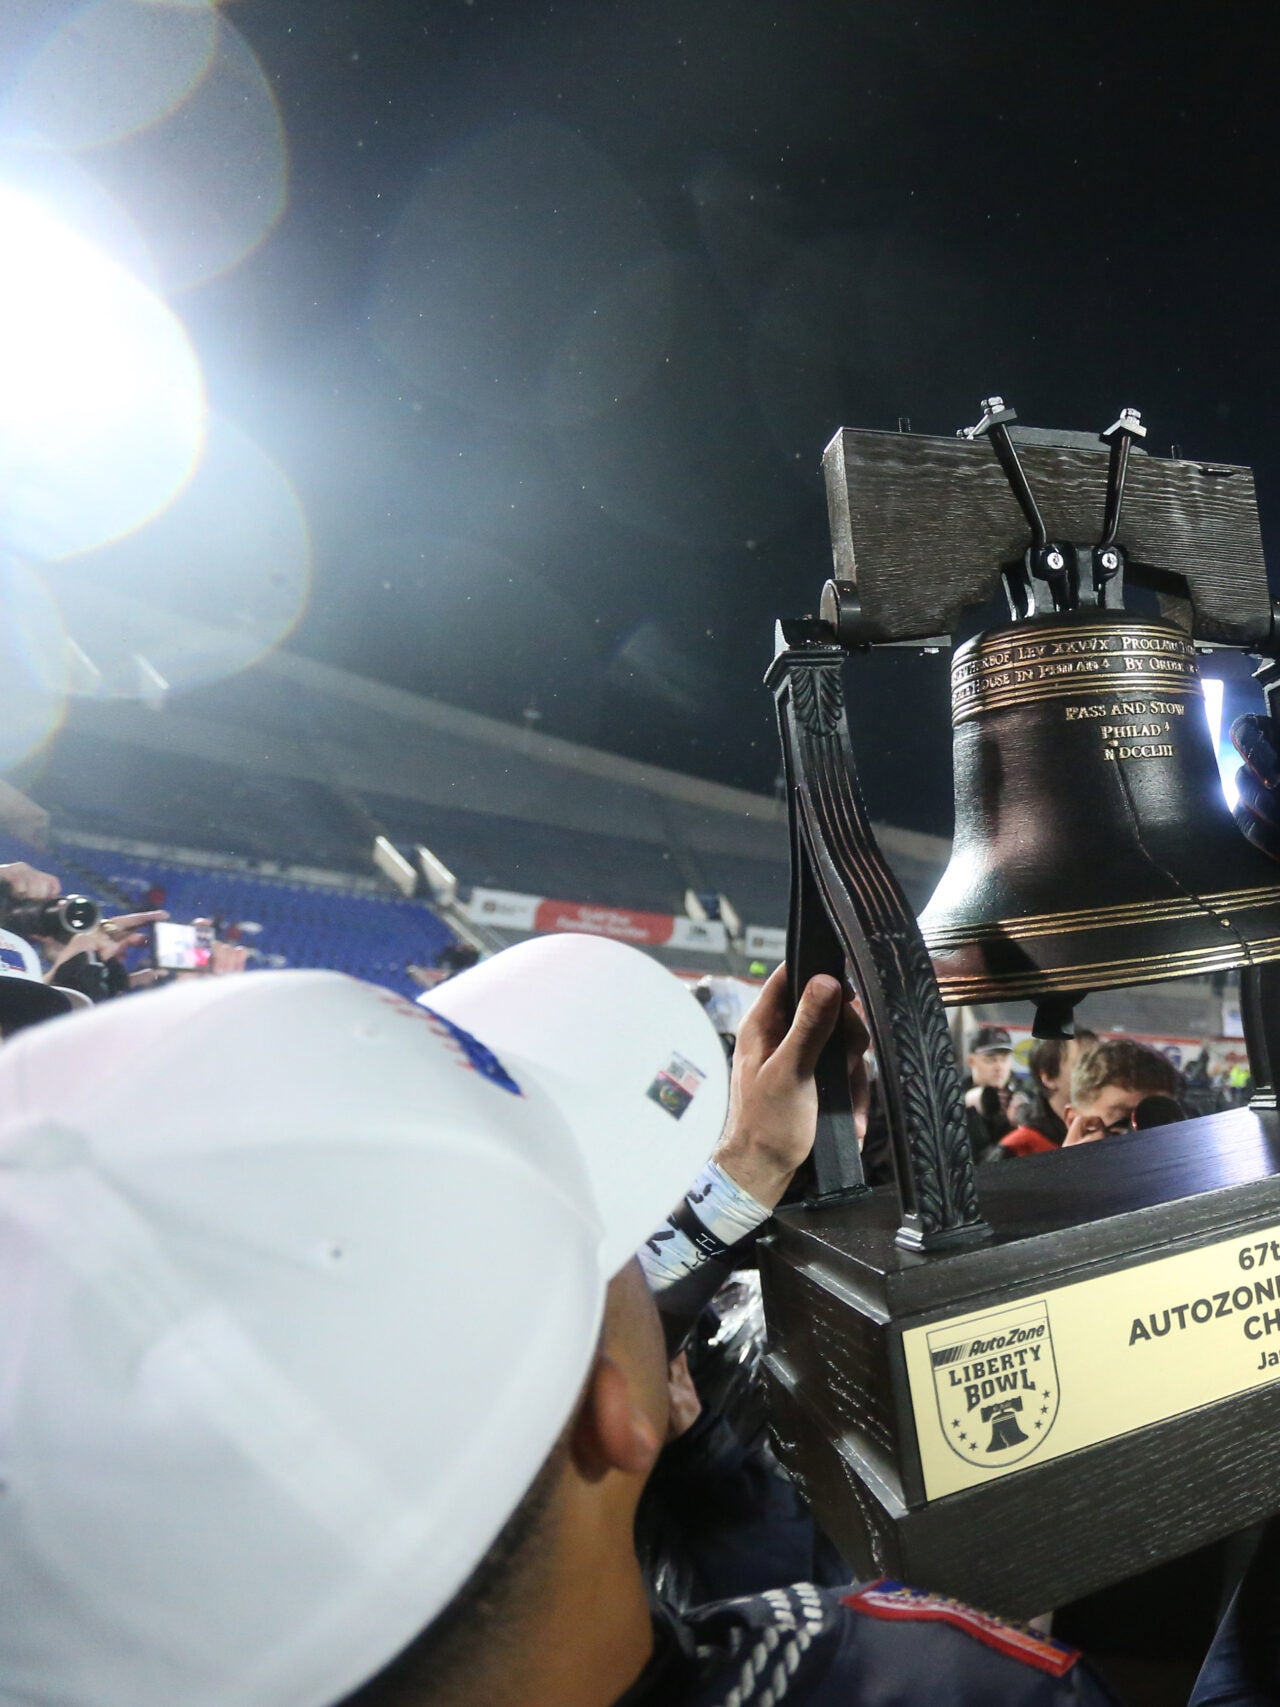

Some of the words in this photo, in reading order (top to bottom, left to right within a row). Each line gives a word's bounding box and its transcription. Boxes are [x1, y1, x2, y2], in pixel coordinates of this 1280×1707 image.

[1015, 668, 1034, 682] IN
[1124, 657, 1144, 672] BY
[1065, 704, 1107, 721] PASS
[1111, 701, 1147, 716] AND
[1150, 701, 1185, 716] STOW
[968, 1324, 1045, 1358] AutoZone
[948, 1344, 1042, 1387] LIBERTY
[963, 1368, 1036, 1414] BOWL
